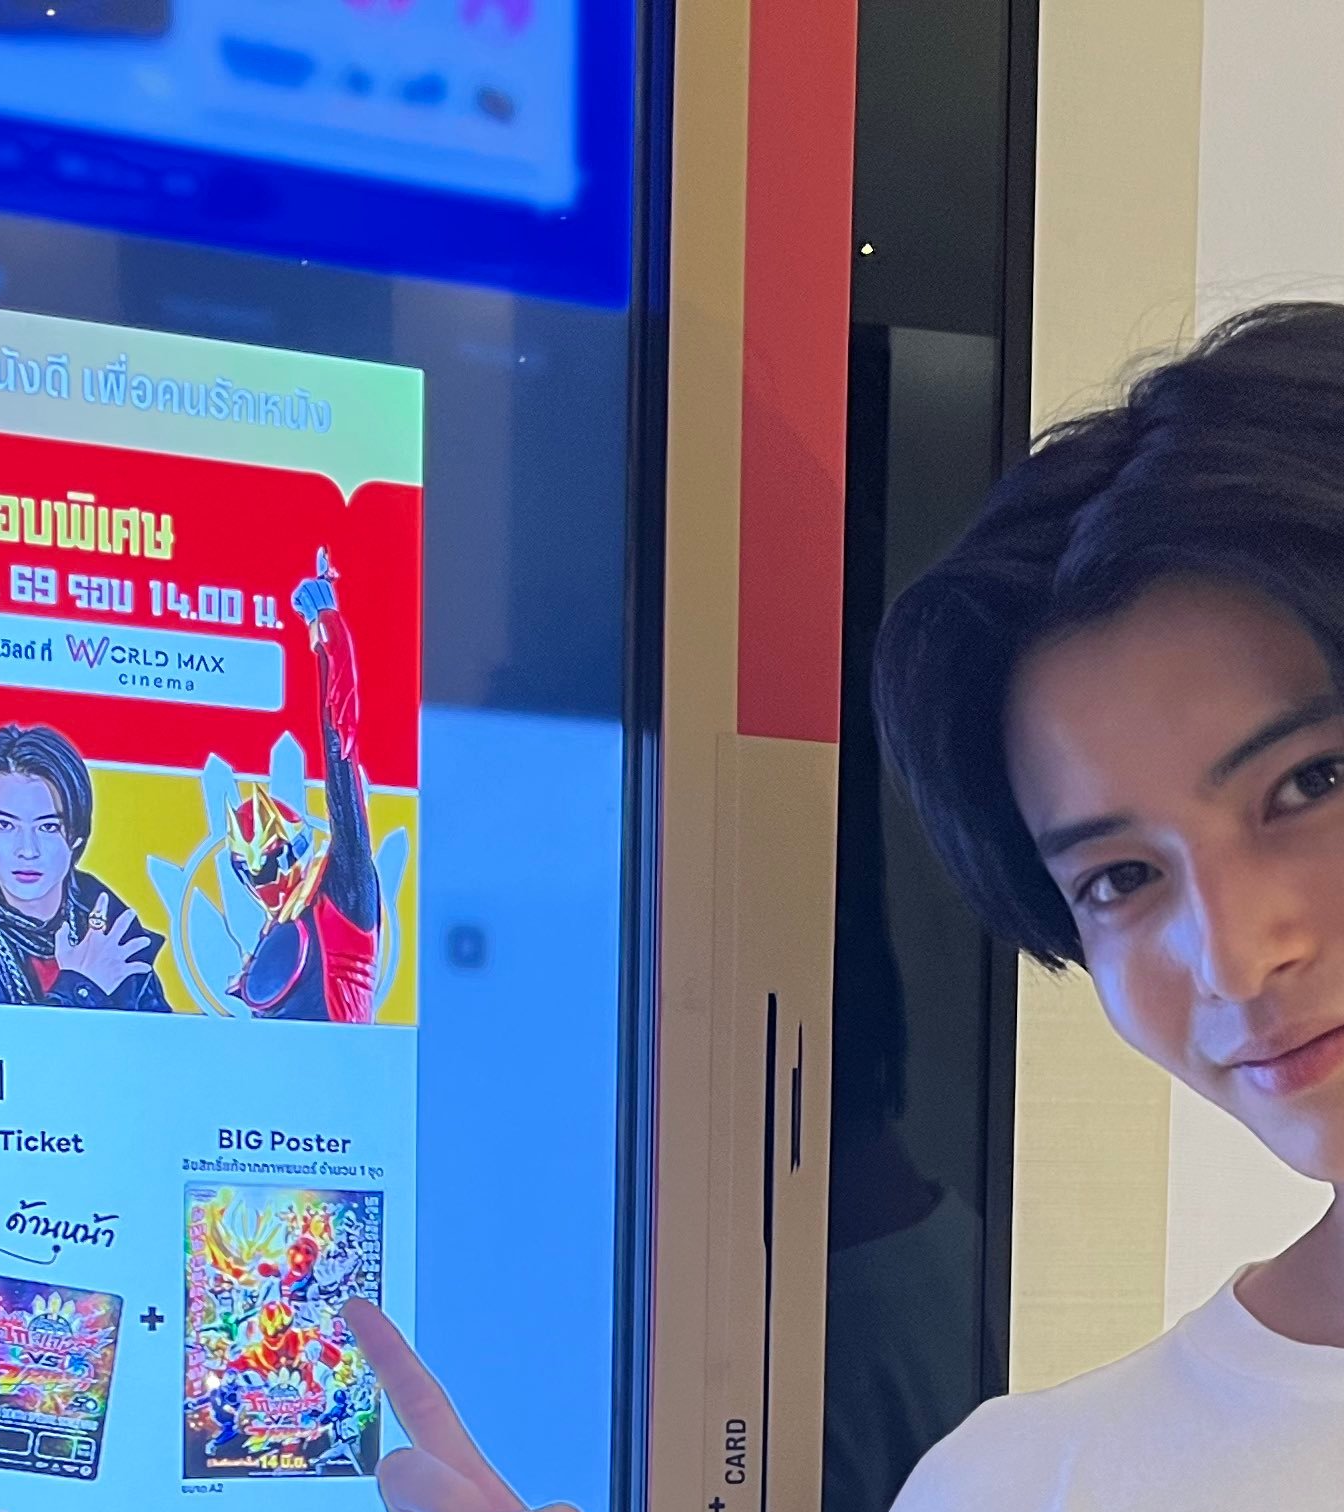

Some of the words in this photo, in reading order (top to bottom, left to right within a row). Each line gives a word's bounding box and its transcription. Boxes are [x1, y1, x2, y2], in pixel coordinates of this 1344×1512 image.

[82, 353, 333, 433] เพื่อคนรักหนัง
[10, 565, 58, 605] 69
[68, 573, 134, 614] รอบ
[150, 580, 244, 626] 14.00
[254, 593, 285, 629] น.
[40, 636, 53, 662] ที่
[66, 632, 168, 670] WORLD
[177, 653, 225, 675] MAX
[119, 671, 195, 692] cinema
[218, 1129, 263, 1150] BIG
[271, 1131, 352, 1154] Poster
[4, 1201, 119, 1249] ด้านหน้า
[259, 1455, 277, 1469] 14
[724, 1418, 746, 1485] CARD
